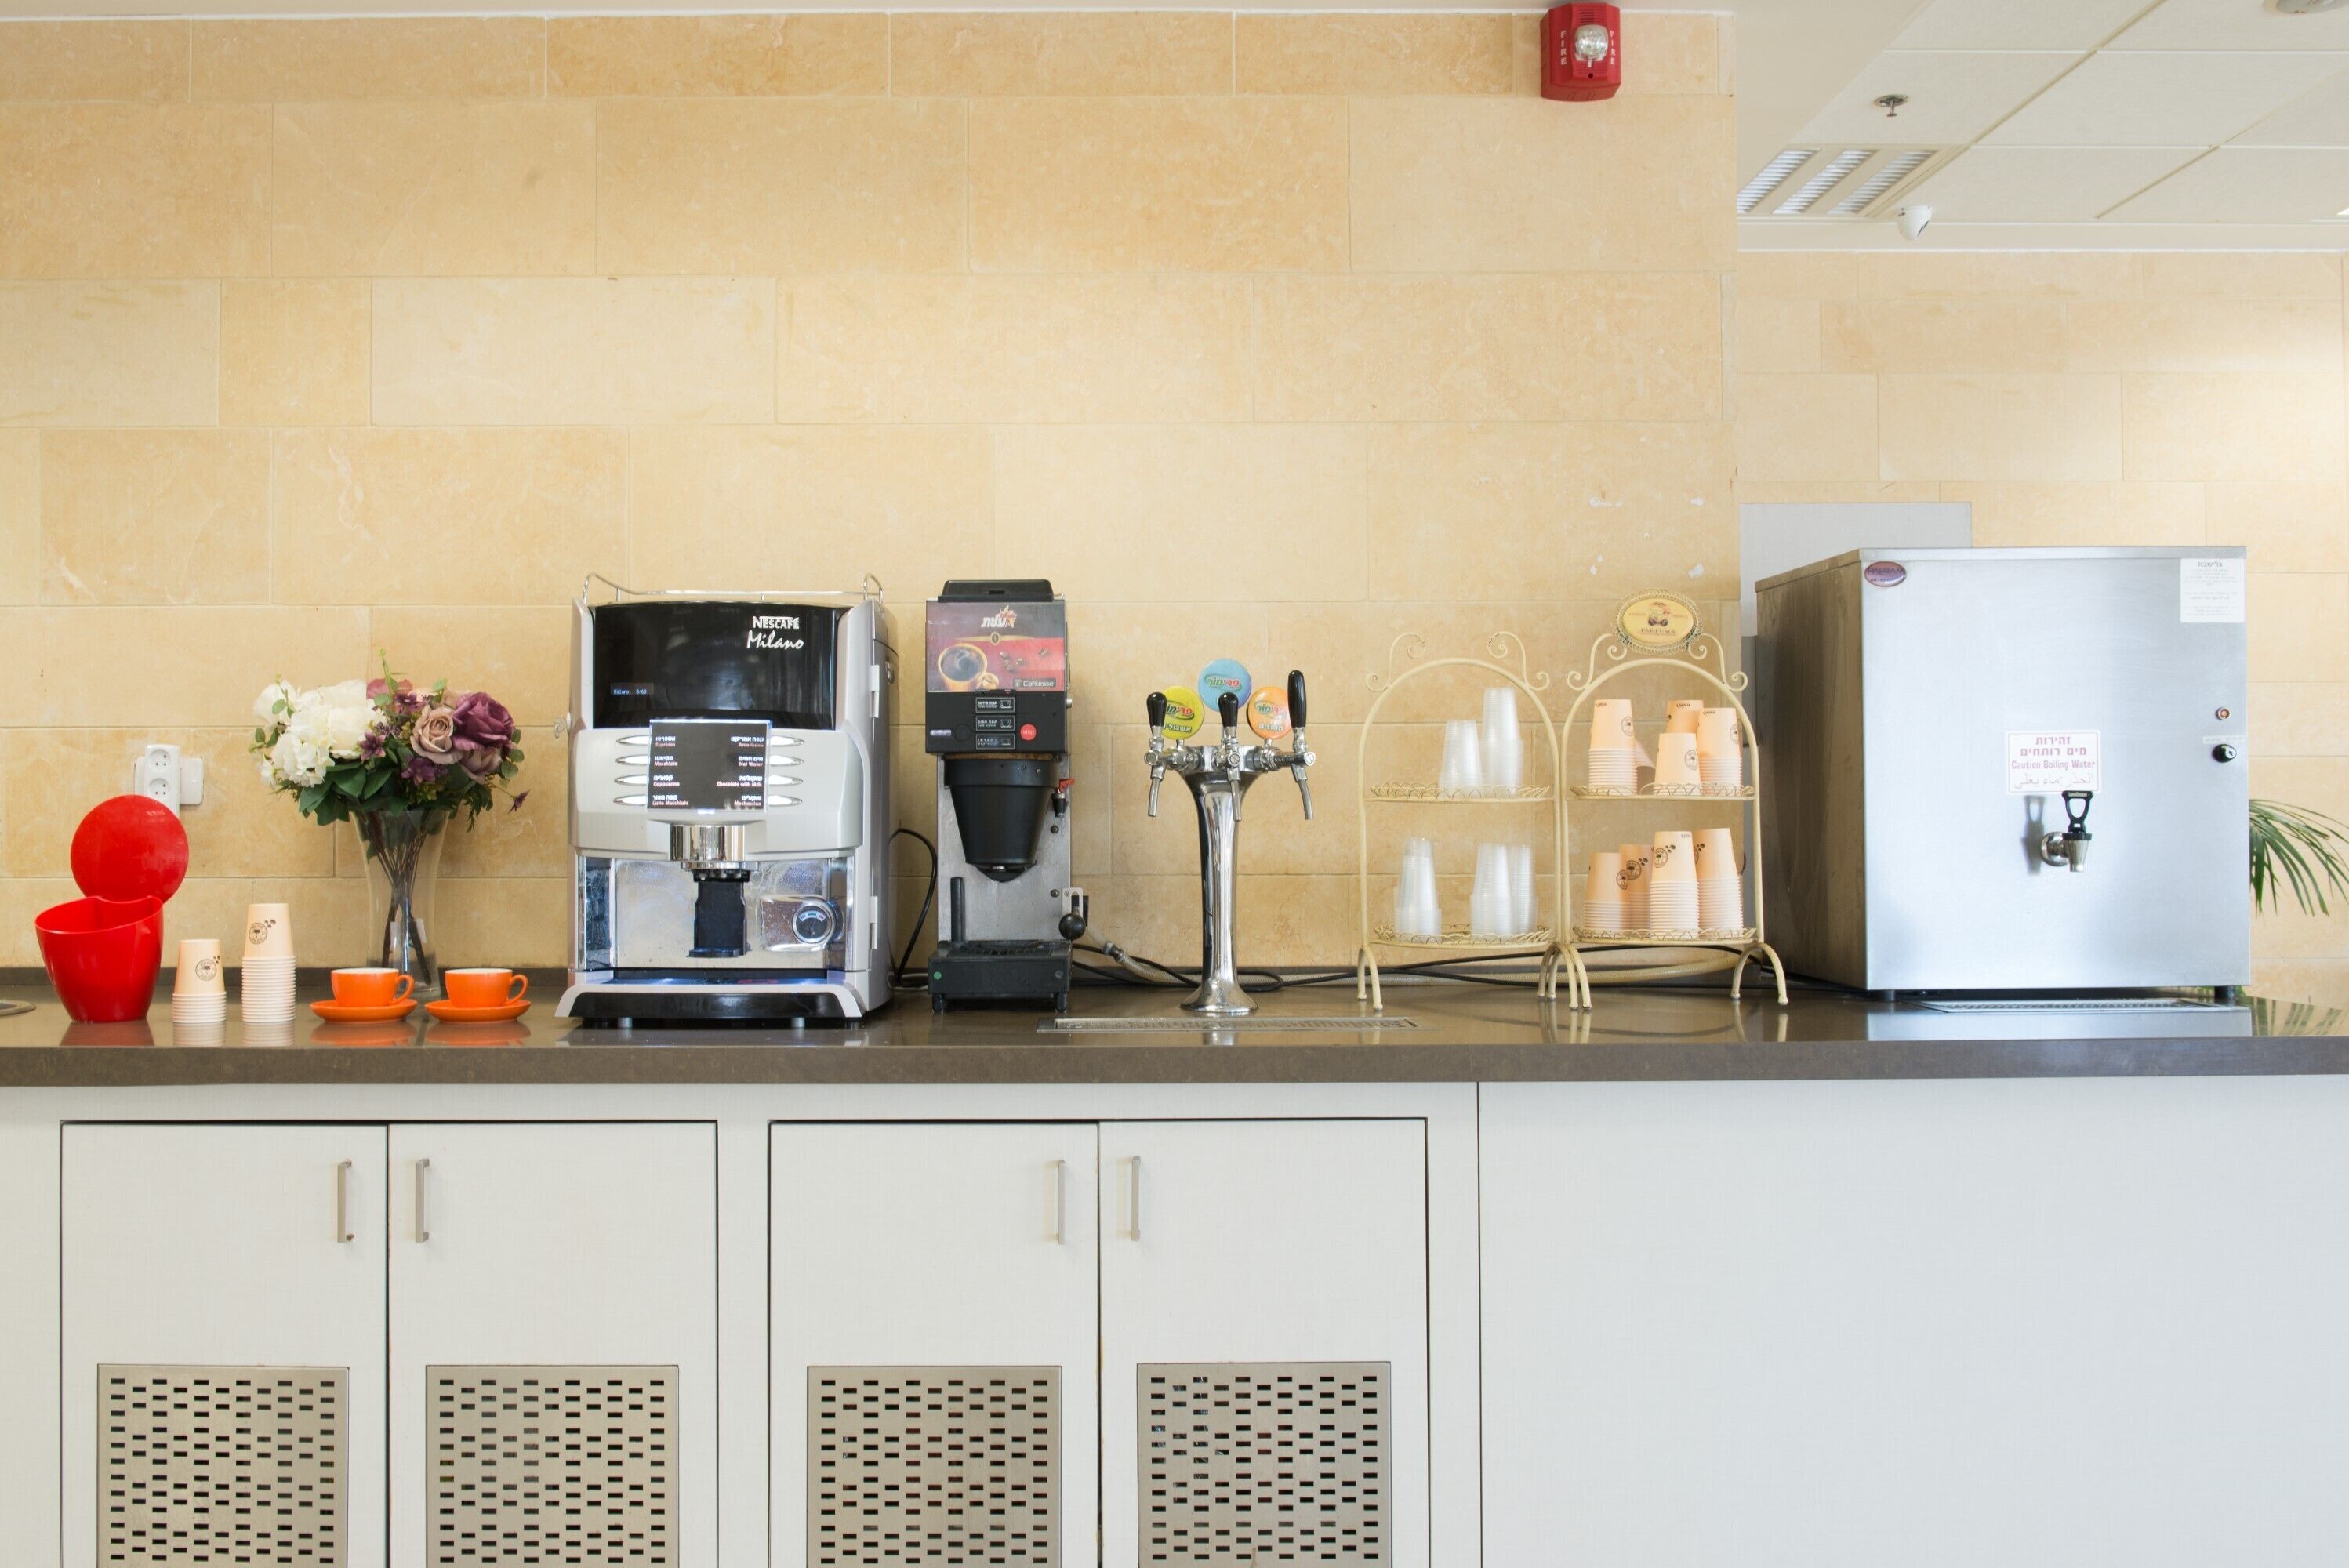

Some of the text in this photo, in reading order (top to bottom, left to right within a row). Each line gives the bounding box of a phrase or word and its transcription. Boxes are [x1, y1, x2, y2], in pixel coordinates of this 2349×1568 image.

[746, 630, 804, 650] Milano
[1167, 704, 1193, 715] פרימו
[2035, 736, 2071, 745] זהירות
[2012, 760, 2095, 771] Caution Boiling Water
